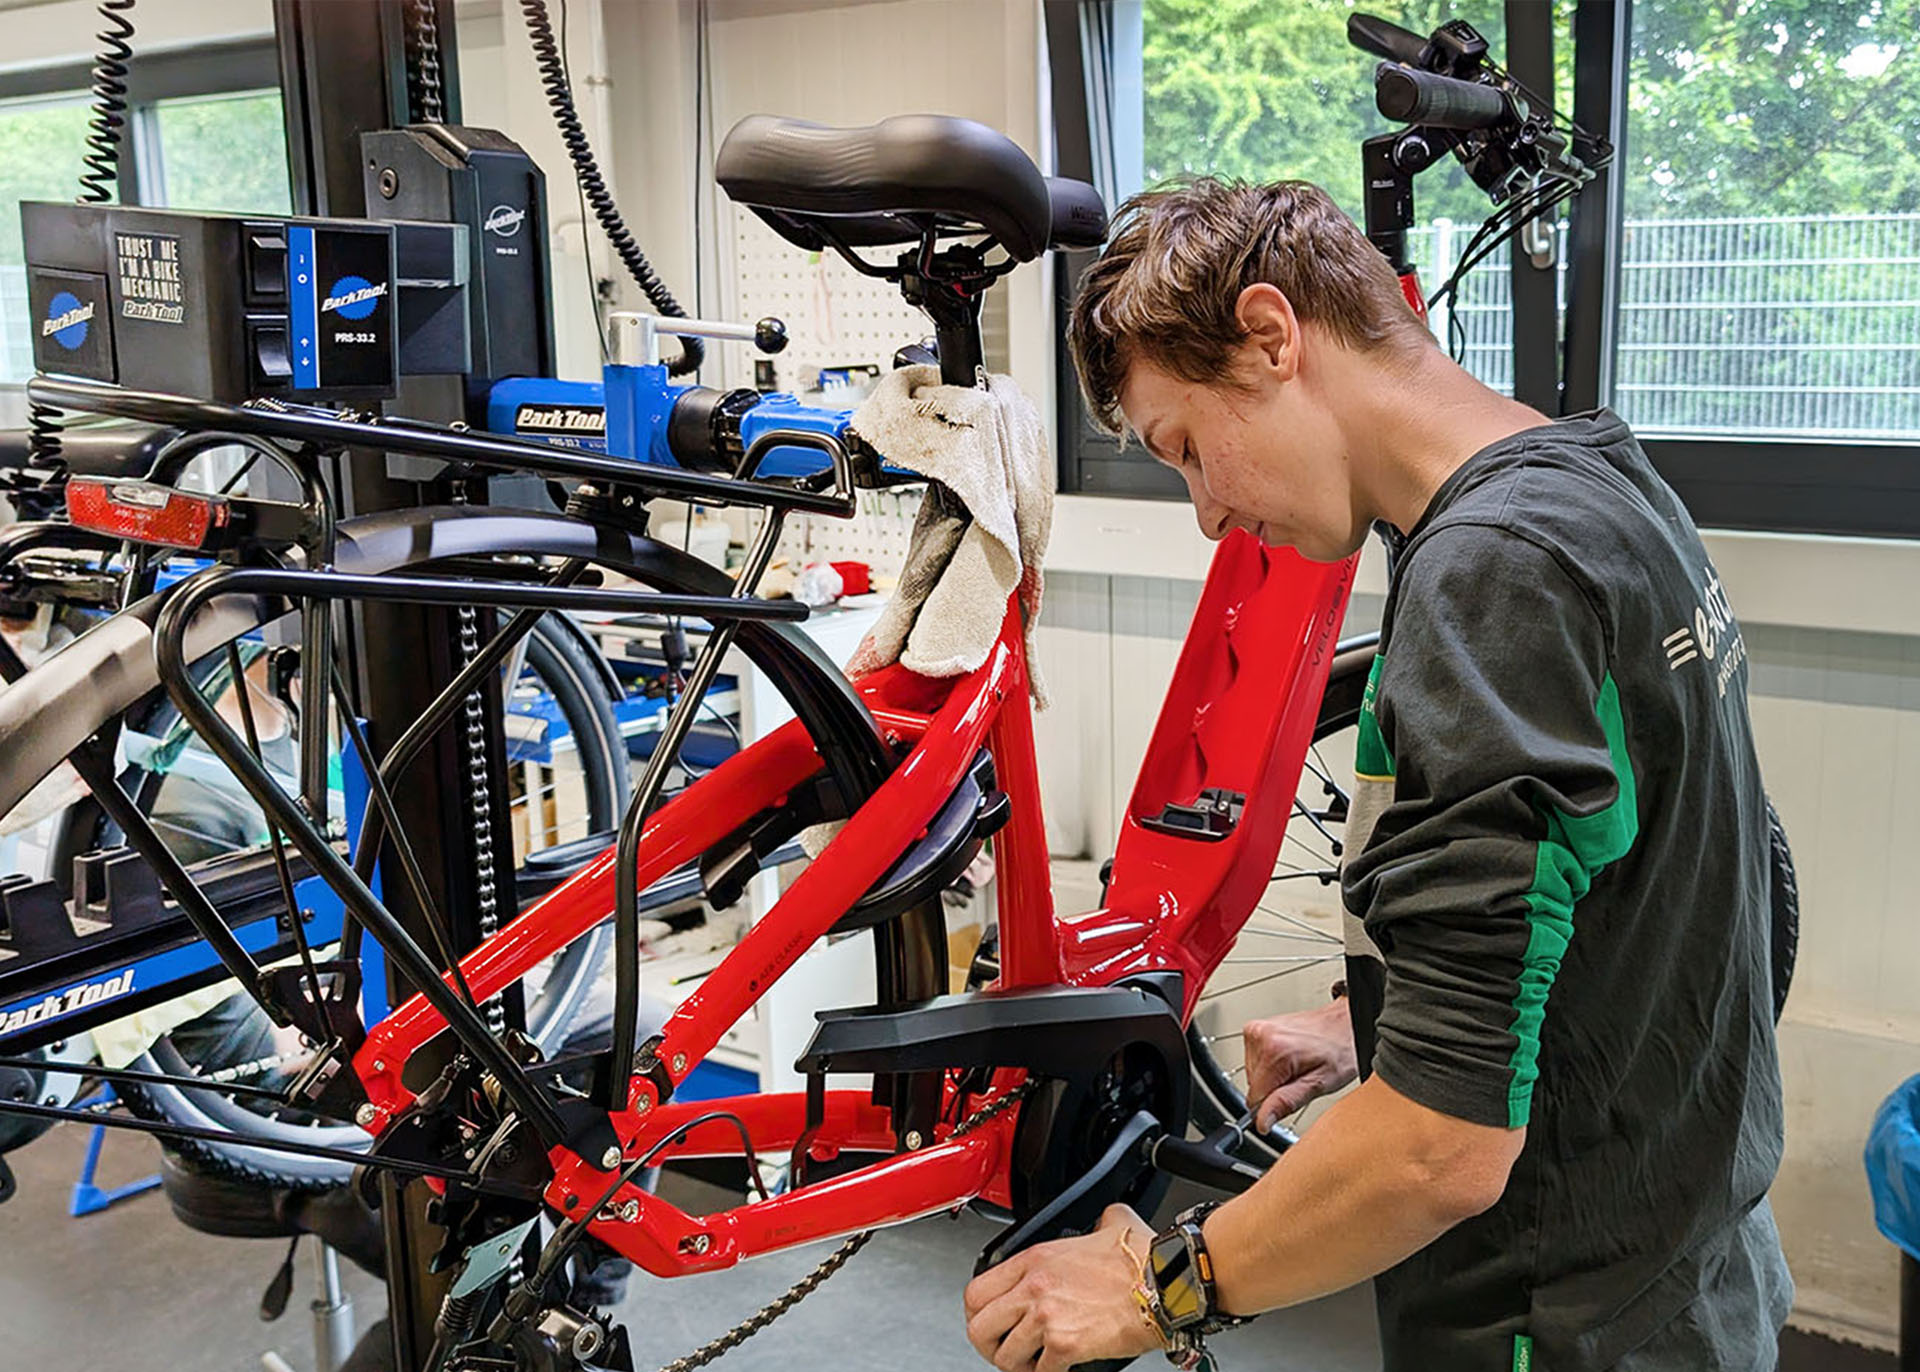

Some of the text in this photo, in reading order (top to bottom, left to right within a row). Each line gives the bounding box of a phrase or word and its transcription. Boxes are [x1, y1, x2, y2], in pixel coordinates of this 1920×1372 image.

[117, 236, 179, 261] TRUST ME
[119, 257, 180, 281] I'M A BIKE
[121, 277, 182, 302] MECHANIC
[335, 332, 377, 344] PRS-33.2
